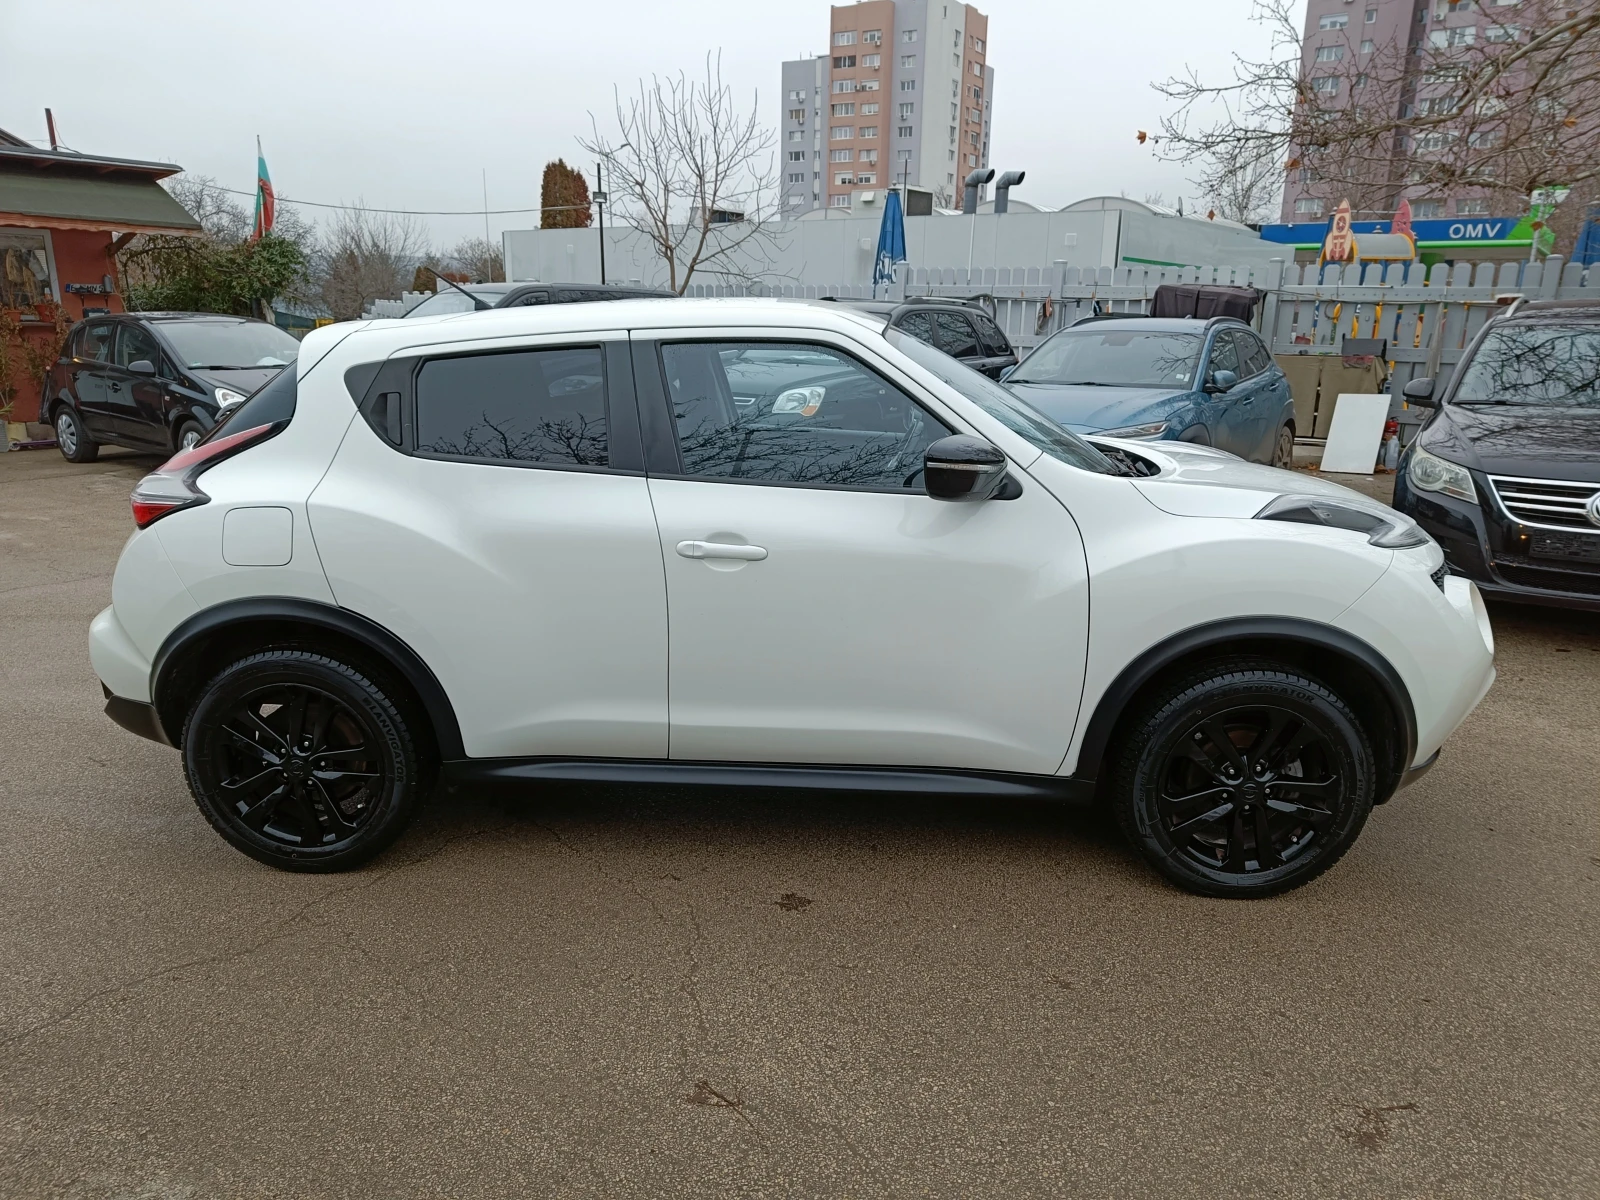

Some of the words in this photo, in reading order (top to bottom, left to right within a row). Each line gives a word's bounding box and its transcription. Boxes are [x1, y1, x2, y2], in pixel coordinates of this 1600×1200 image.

[1449, 223, 1502, 239] OMV
[1226, 684, 1315, 703] ANVIGATOR
[369, 704, 404, 783] LANVIGATOR
